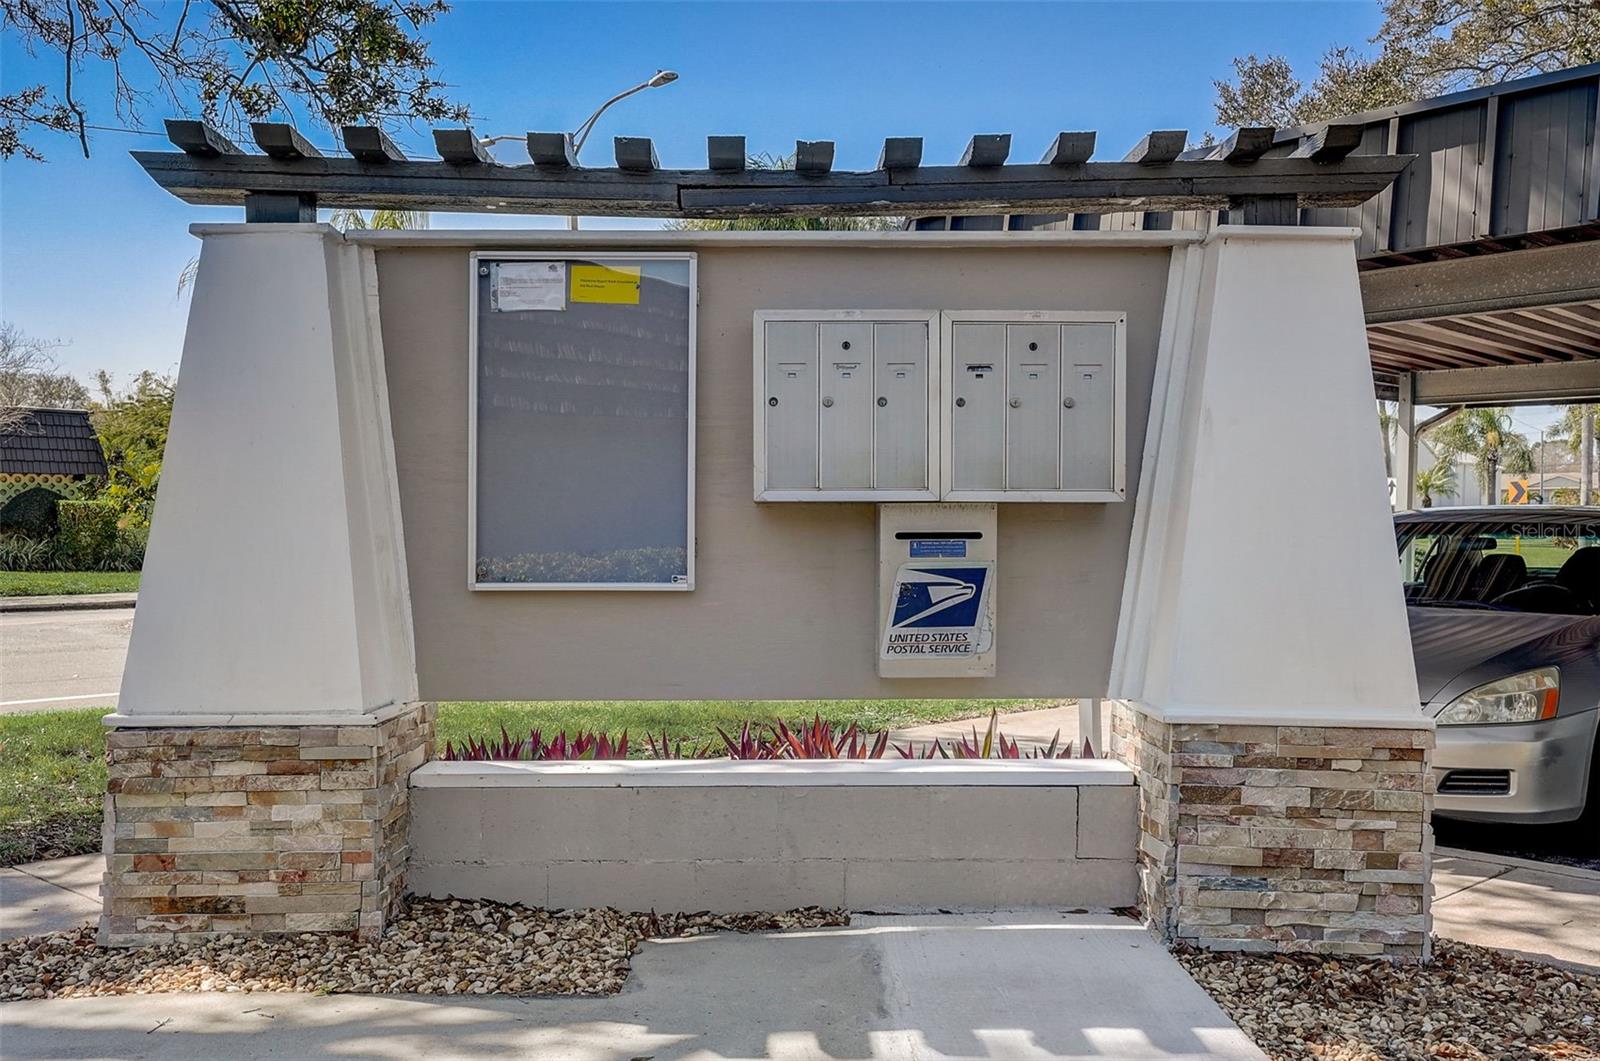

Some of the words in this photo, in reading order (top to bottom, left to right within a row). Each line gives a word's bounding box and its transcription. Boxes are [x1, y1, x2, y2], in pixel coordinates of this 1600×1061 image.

[889, 633, 930, 643] UNITED
[931, 632, 968, 642] STATES
[886, 644, 926, 654] POSTAL
[928, 643, 972, 654] SERVICE
